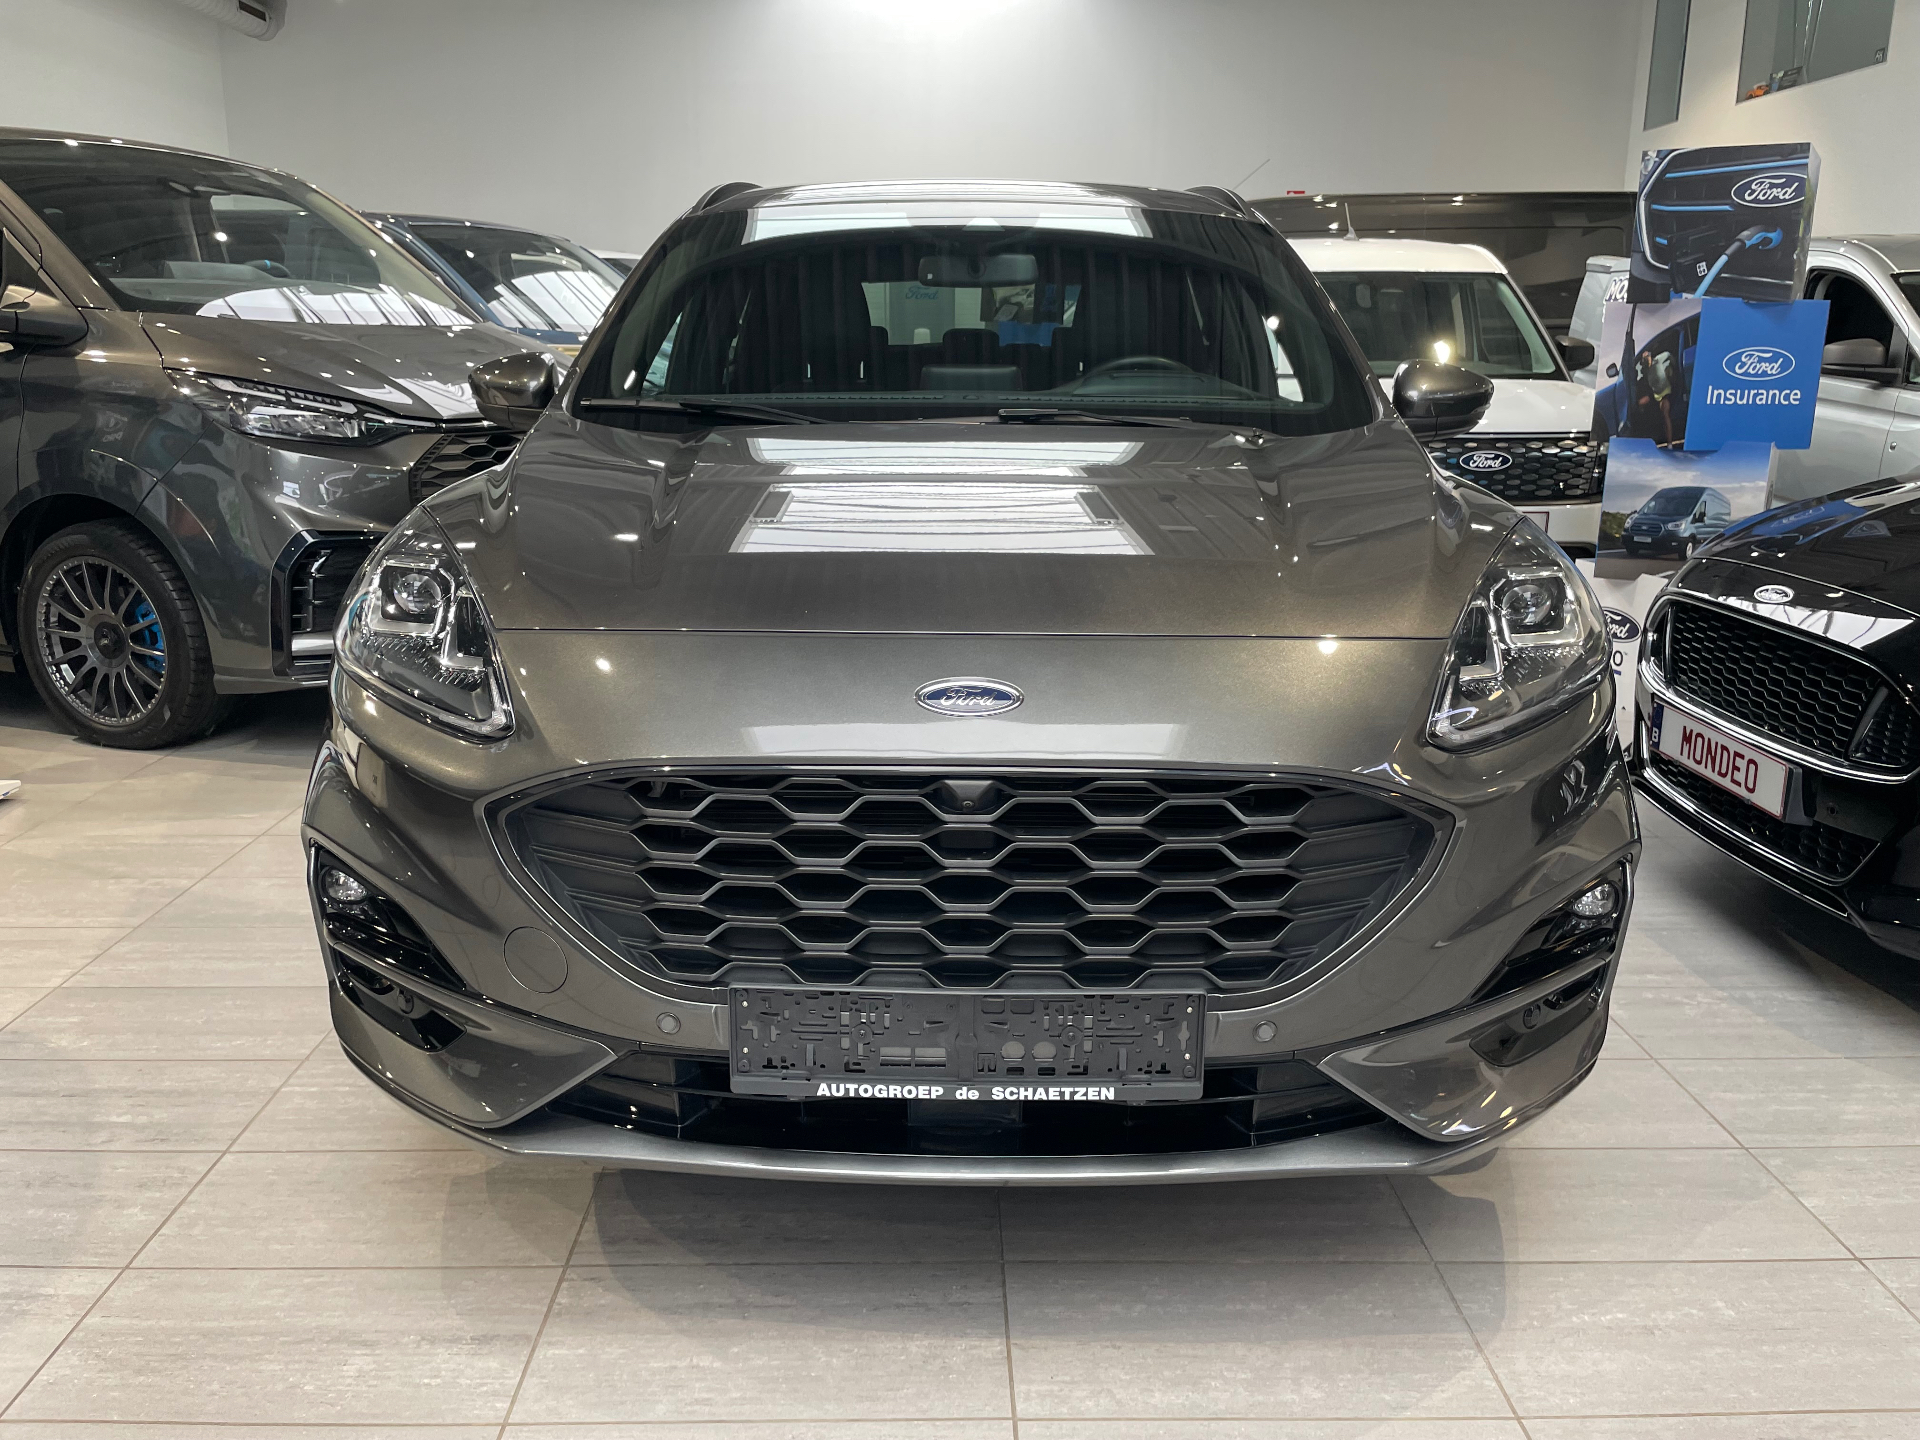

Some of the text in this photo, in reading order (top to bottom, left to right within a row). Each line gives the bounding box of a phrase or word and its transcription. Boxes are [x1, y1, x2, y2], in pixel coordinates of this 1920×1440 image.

[1744, 178, 1800, 202] Ford
[905, 286, 938, 299] Ford
[1605, 278, 1629, 301] MO
[1735, 351, 1784, 375] Ford
[1706, 385, 1802, 406] Insurance
[1469, 453, 1503, 468] Ford
[940, 687, 998, 706] Ford
[1651, 727, 1659, 742] B
[1680, 726, 1758, 794] MONDEO
[816, 1082, 1115, 1100] AUTOGROEP de SCHAETZEN
